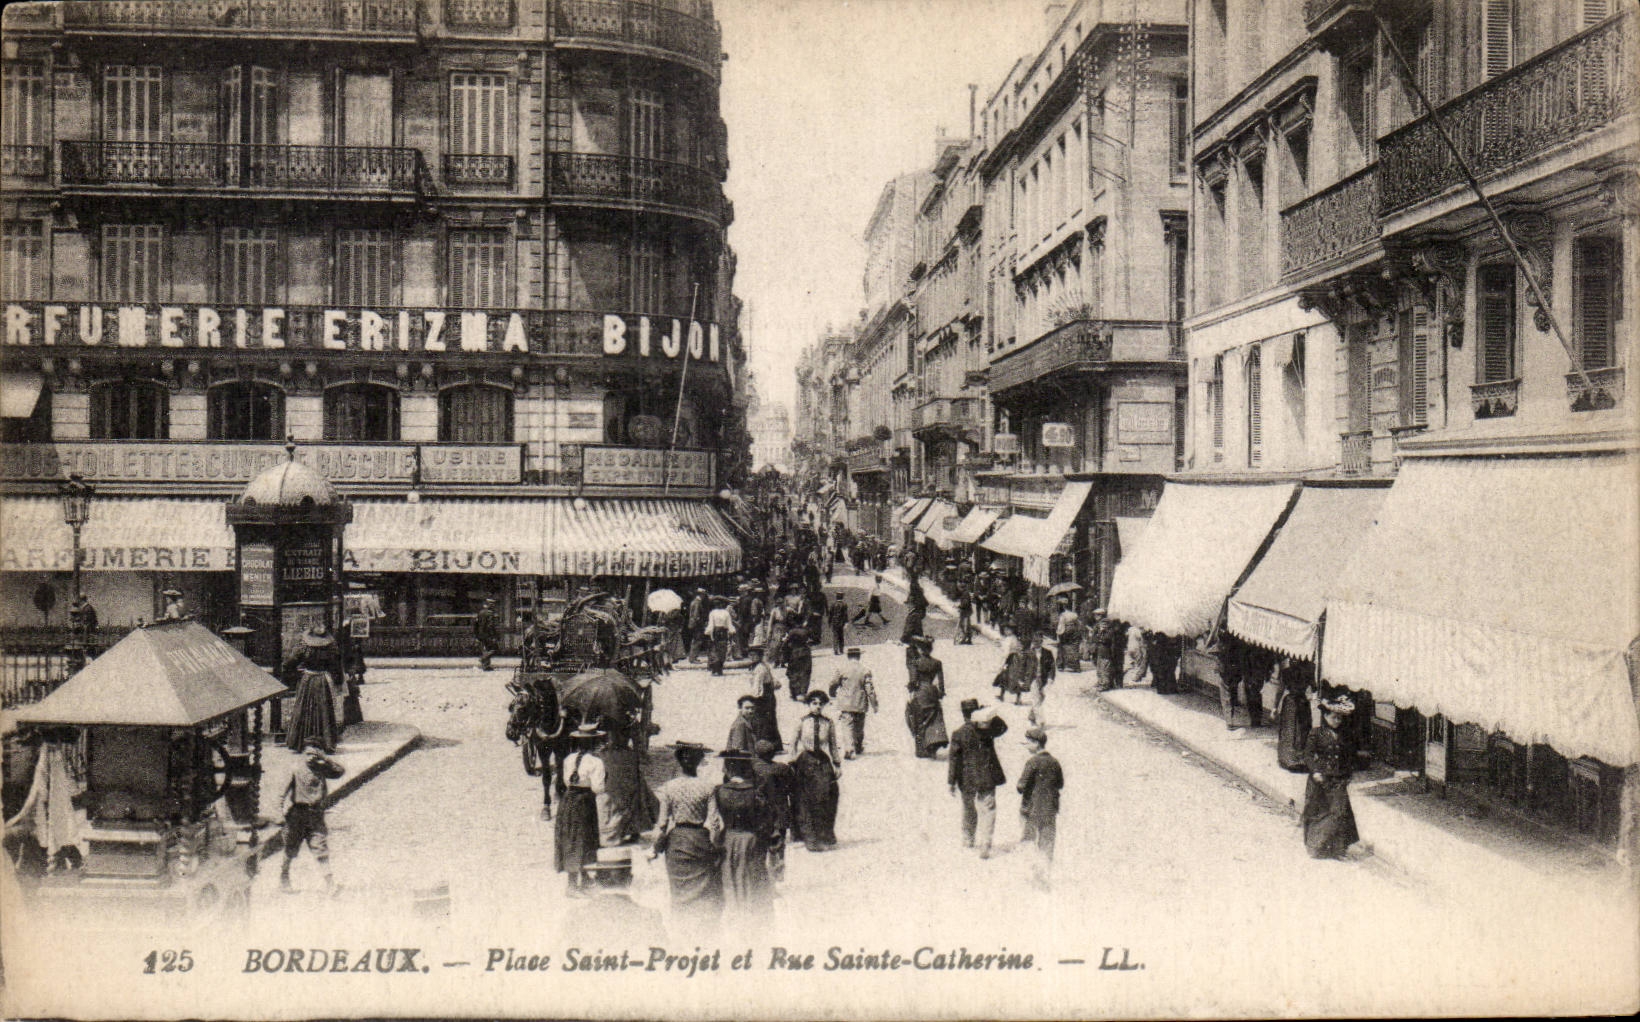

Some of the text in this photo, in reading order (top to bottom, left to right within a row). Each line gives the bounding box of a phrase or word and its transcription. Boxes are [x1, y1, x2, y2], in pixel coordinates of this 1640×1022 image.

[5, 304, 286, 349] RFUMERIE
[322, 309, 529, 353] ERIZMA
[242, 559, 274, 569] CHOCOLAT
[411, 549, 520, 571] BIJON
[282, 567, 325, 580] LIEBIG
